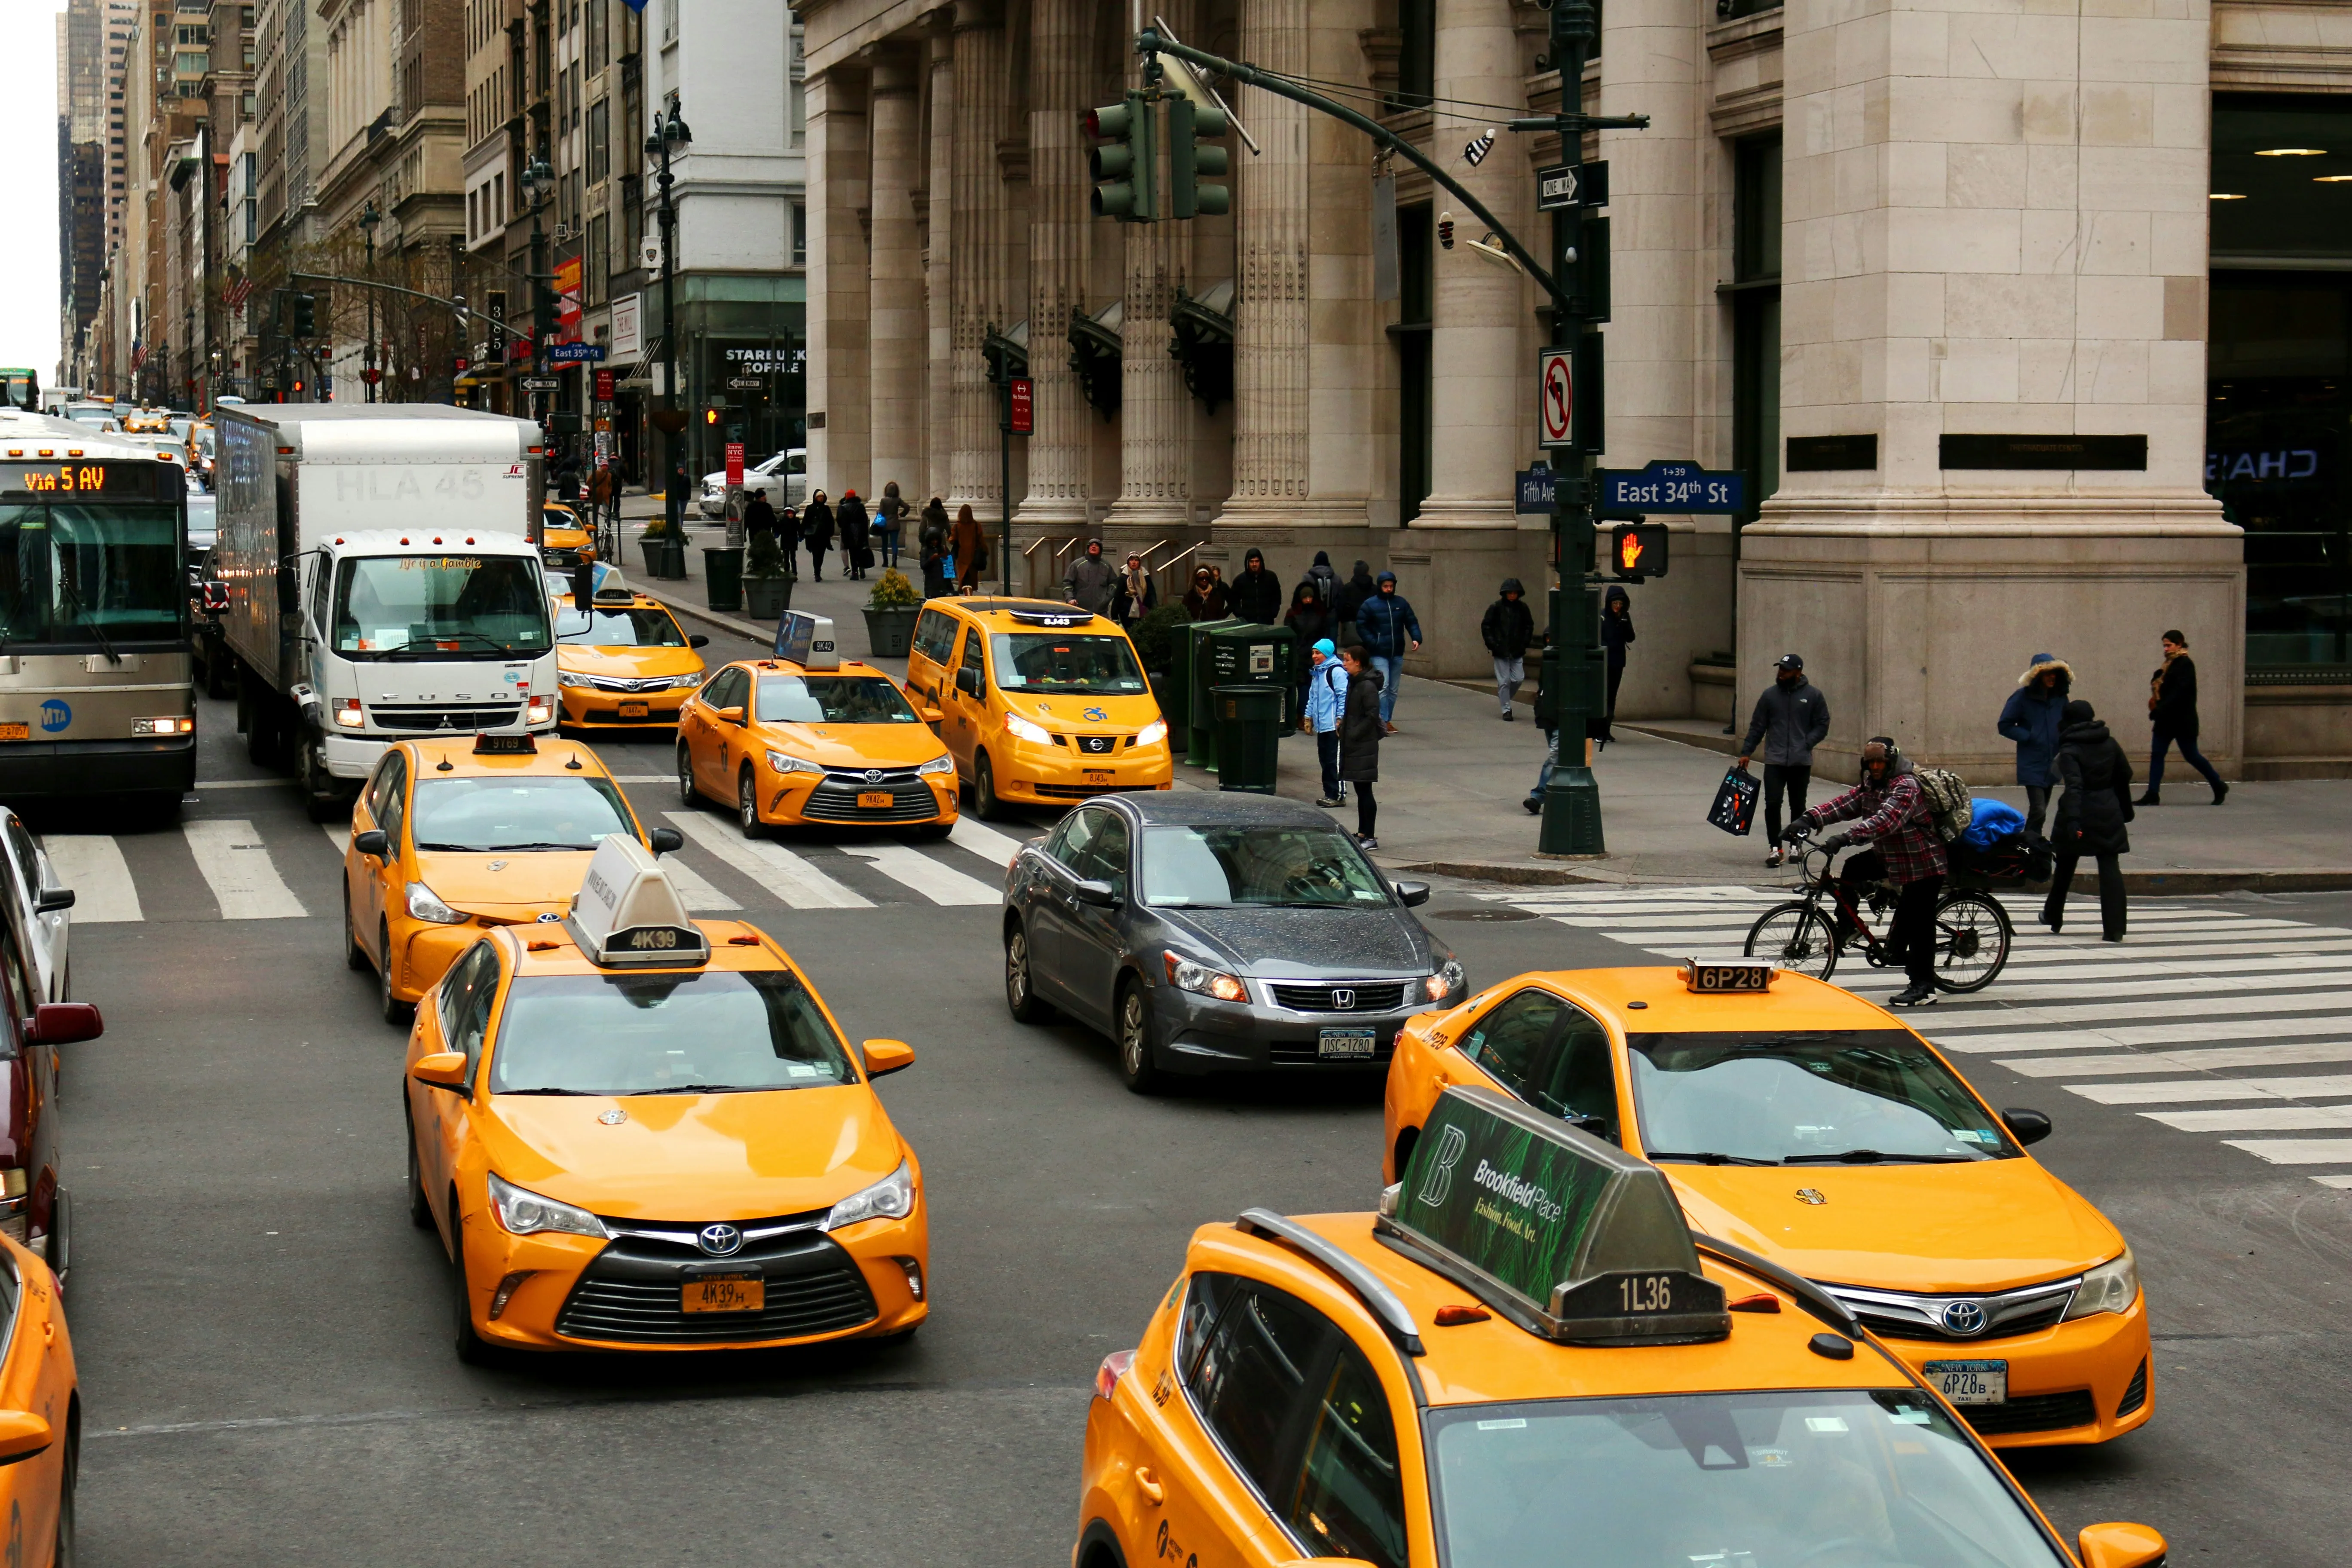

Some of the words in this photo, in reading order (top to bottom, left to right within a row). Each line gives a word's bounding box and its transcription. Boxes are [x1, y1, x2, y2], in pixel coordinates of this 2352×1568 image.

[1546, 180, 1557, 195] ONE
[1562, 177, 1574, 192] WAY
[555, 349, 571, 357] East
[574, 347, 588, 357] 35th
[61, 467, 74, 490] 5
[80, 467, 104, 490] AV
[336, 470, 422, 502] HLA
[435, 469, 484, 501] 45
[1524, 482, 1540, 502] Fifth
[1541, 485, 1555, 502] Ave
[1617, 481, 1659, 502] East
[1665, 480, 1701, 503] 34th
[1708, 482, 1728, 503] St
[399, 557, 416, 571] Life
[419, 558, 427, 570] is
[429, 560, 438, 568] a
[440, 557, 482, 572] Gamble
[816, 641, 832, 651] 9K42
[382, 692, 508, 701] FUSO
[41, 707, 67, 726] MTA
[494, 737, 519, 749] 9Y69
[631, 930, 677, 949] 4K39
[1703, 967, 1762, 989] 6P28
[1474, 1197, 1502, 1225] Fashion.
[1502, 1211, 1523, 1237] Food.
[1524, 1223, 1536, 1243] Art.
[1620, 1276, 1671, 1311] 1L36
[1944, 1364, 1963, 1372] NEW
[1966, 1364, 1987, 1372] YORK
